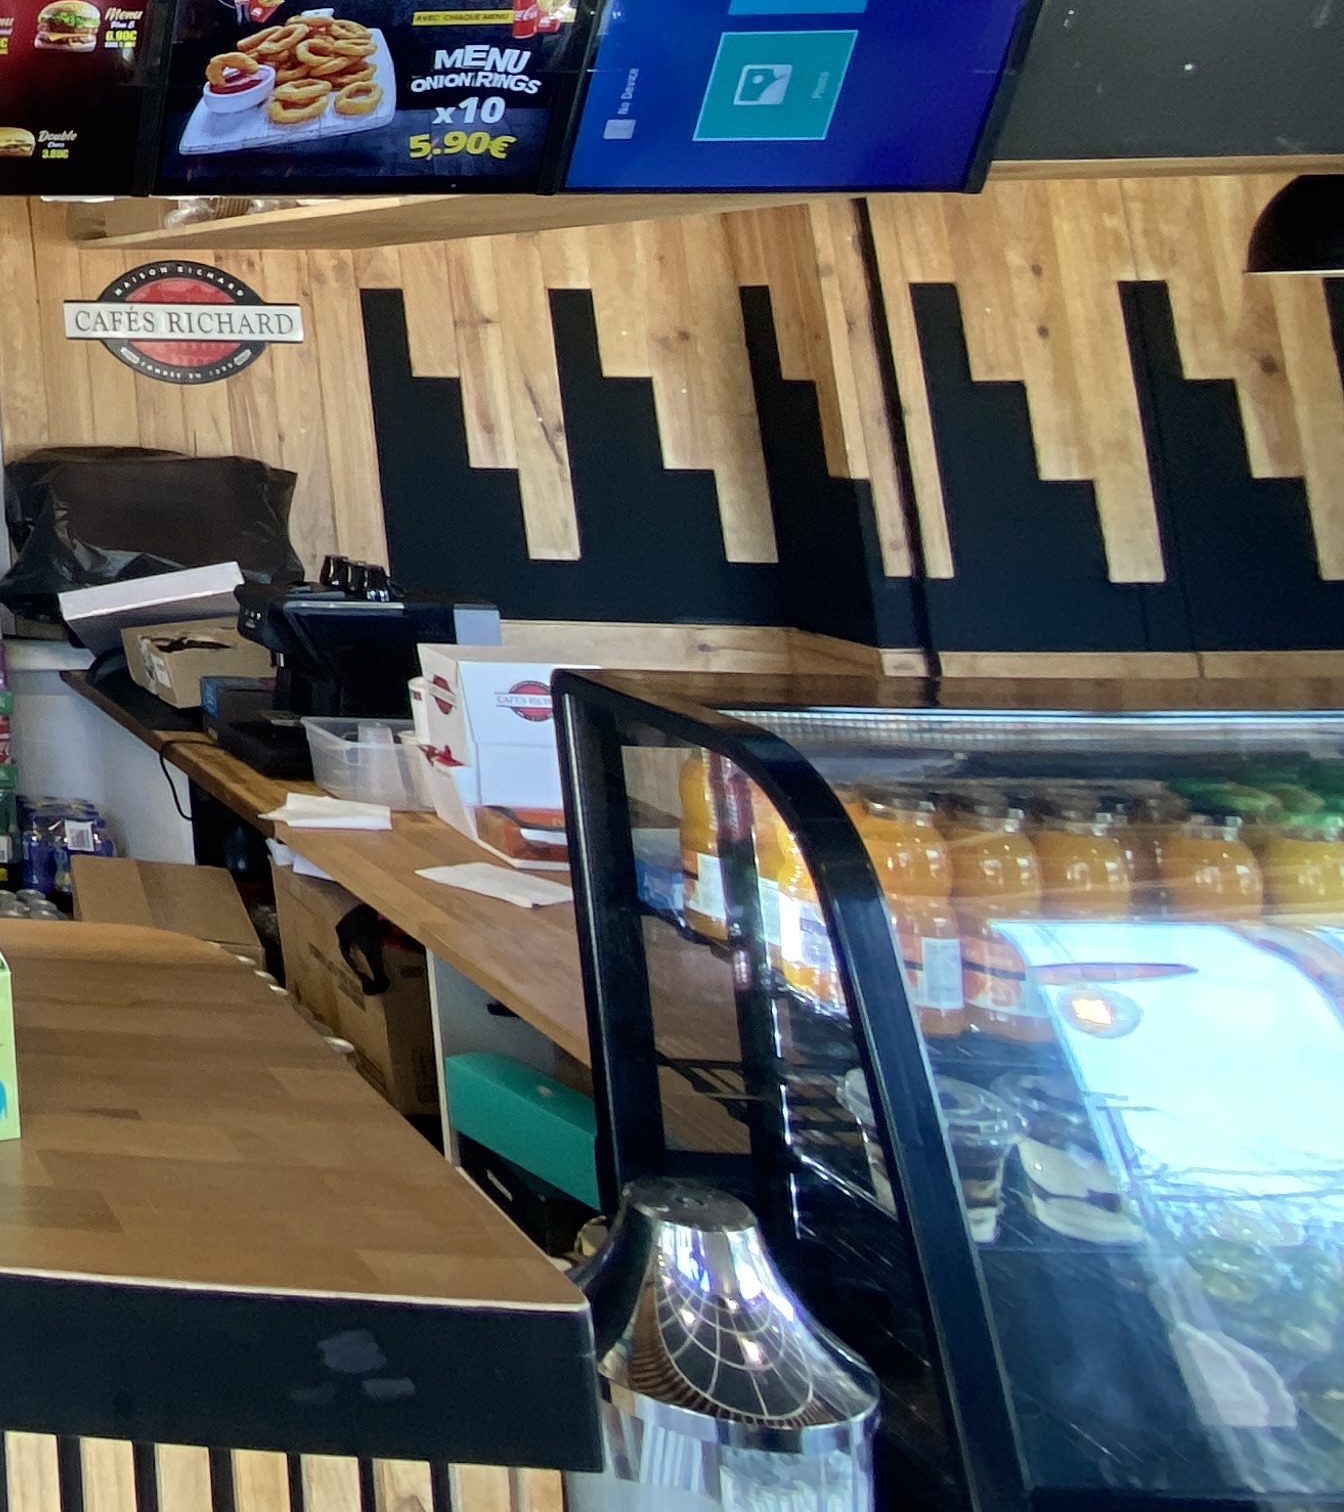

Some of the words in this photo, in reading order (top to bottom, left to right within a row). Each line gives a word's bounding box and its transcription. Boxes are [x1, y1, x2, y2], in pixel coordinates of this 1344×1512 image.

[104, 7, 143, 20] Menu
[434, 44, 531, 74] MENU
[411, 73, 472, 94] ONION
[476, 71, 542, 94] RINGS
[432, 96, 506, 125] x10
[37, 129, 78, 142] Double
[409, 130, 517, 161] 5.90€
[114, 266, 168, 296] MAISON
[177, 266, 244, 296] RICHARD
[75, 305, 155, 333] CAFÉS
[167, 311, 294, 335] RICHARD
